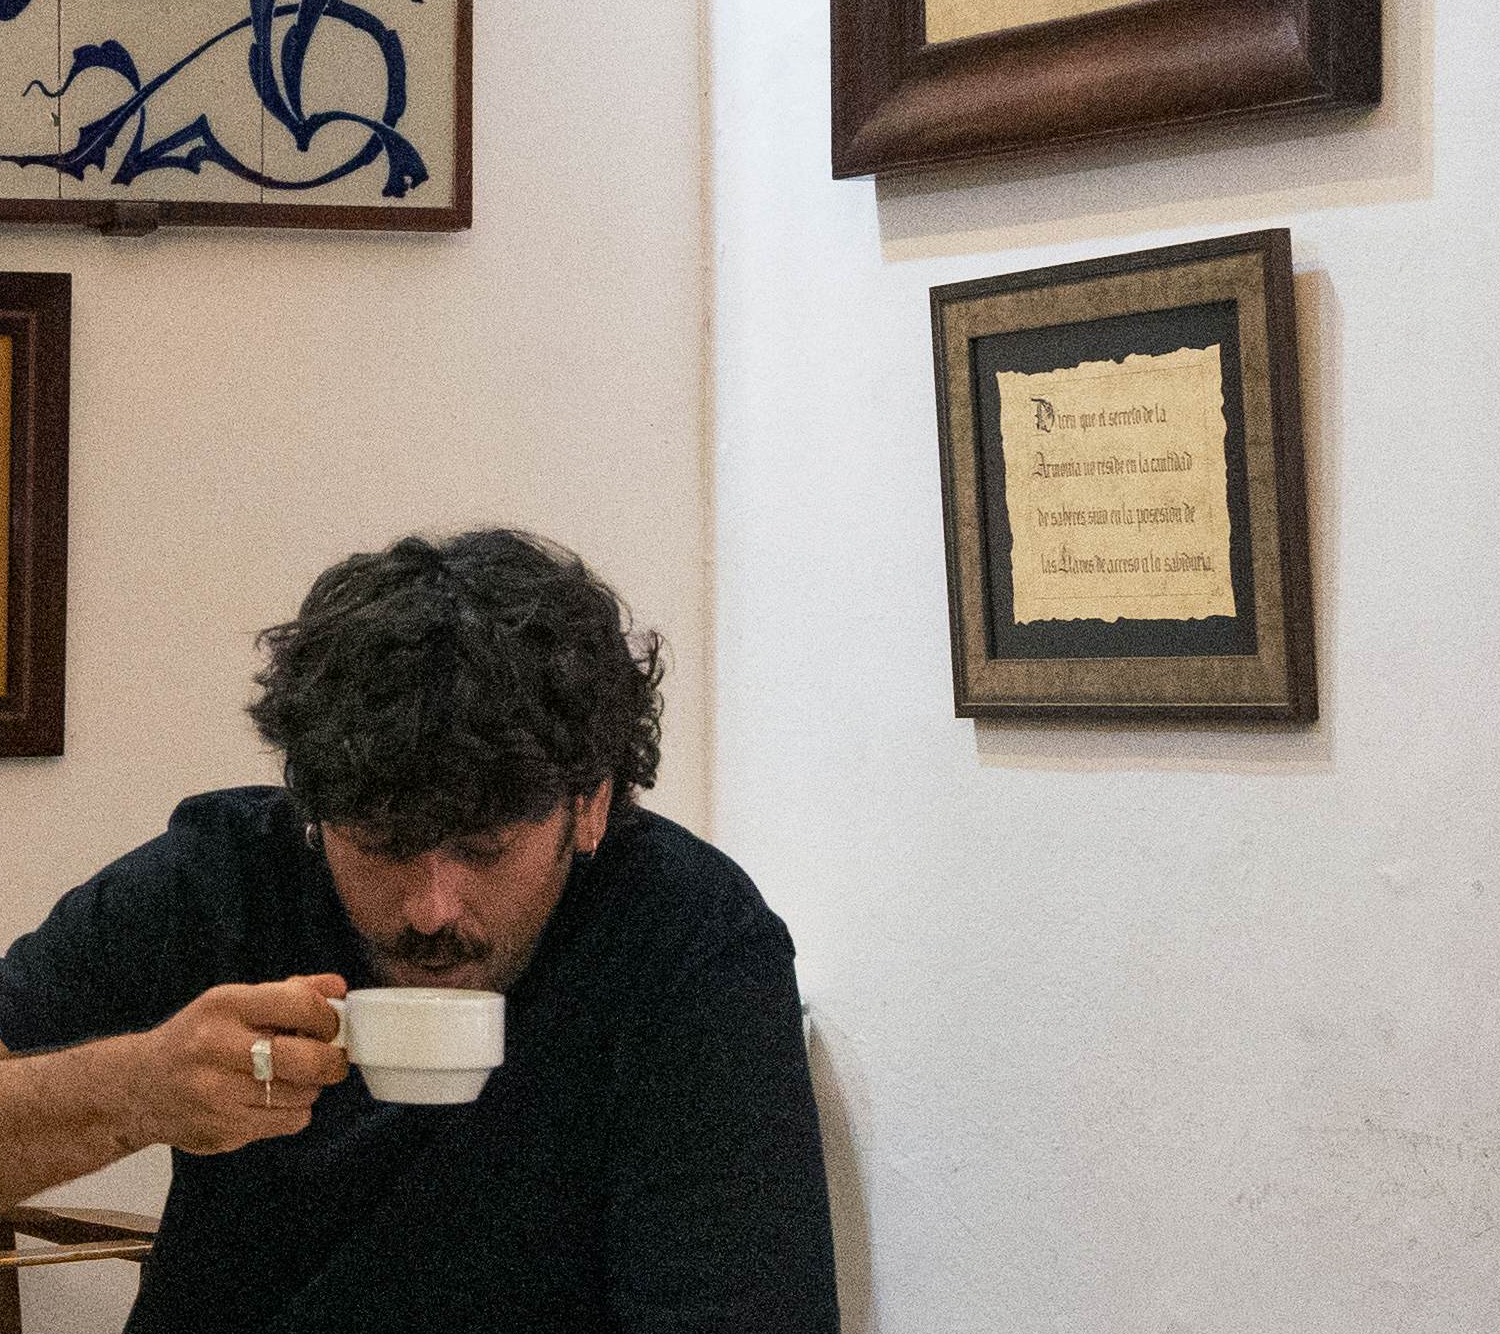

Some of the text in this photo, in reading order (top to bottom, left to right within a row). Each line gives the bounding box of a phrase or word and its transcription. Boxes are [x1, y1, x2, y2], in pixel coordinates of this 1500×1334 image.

[1031, 398, 1076, 433] Dicen
[1080, 411, 1097, 432] que
[1108, 406, 1142, 427] secreto
[1142, 405, 1153, 424] de
[1155, 403, 1167, 424] la
[1098, 456, 1125, 475] reside
[1126, 463, 1138, 475] en
[1138, 452, 1149, 474] la
[1151, 450, 1193, 473] cantidad
[1037, 507, 1048, 527] de
[1051, 505, 1086, 526] saberes
[1110, 510, 1121, 525] en
[1122, 502, 1134, 525] la
[1183, 502, 1195, 523] de
[1041, 553, 1057, 574] las
[1094, 555, 1106, 573] de
[1108, 557, 1139, 574] acceso
[1142, 557, 1150, 573] a
[1150, 548, 1161, 573] la
